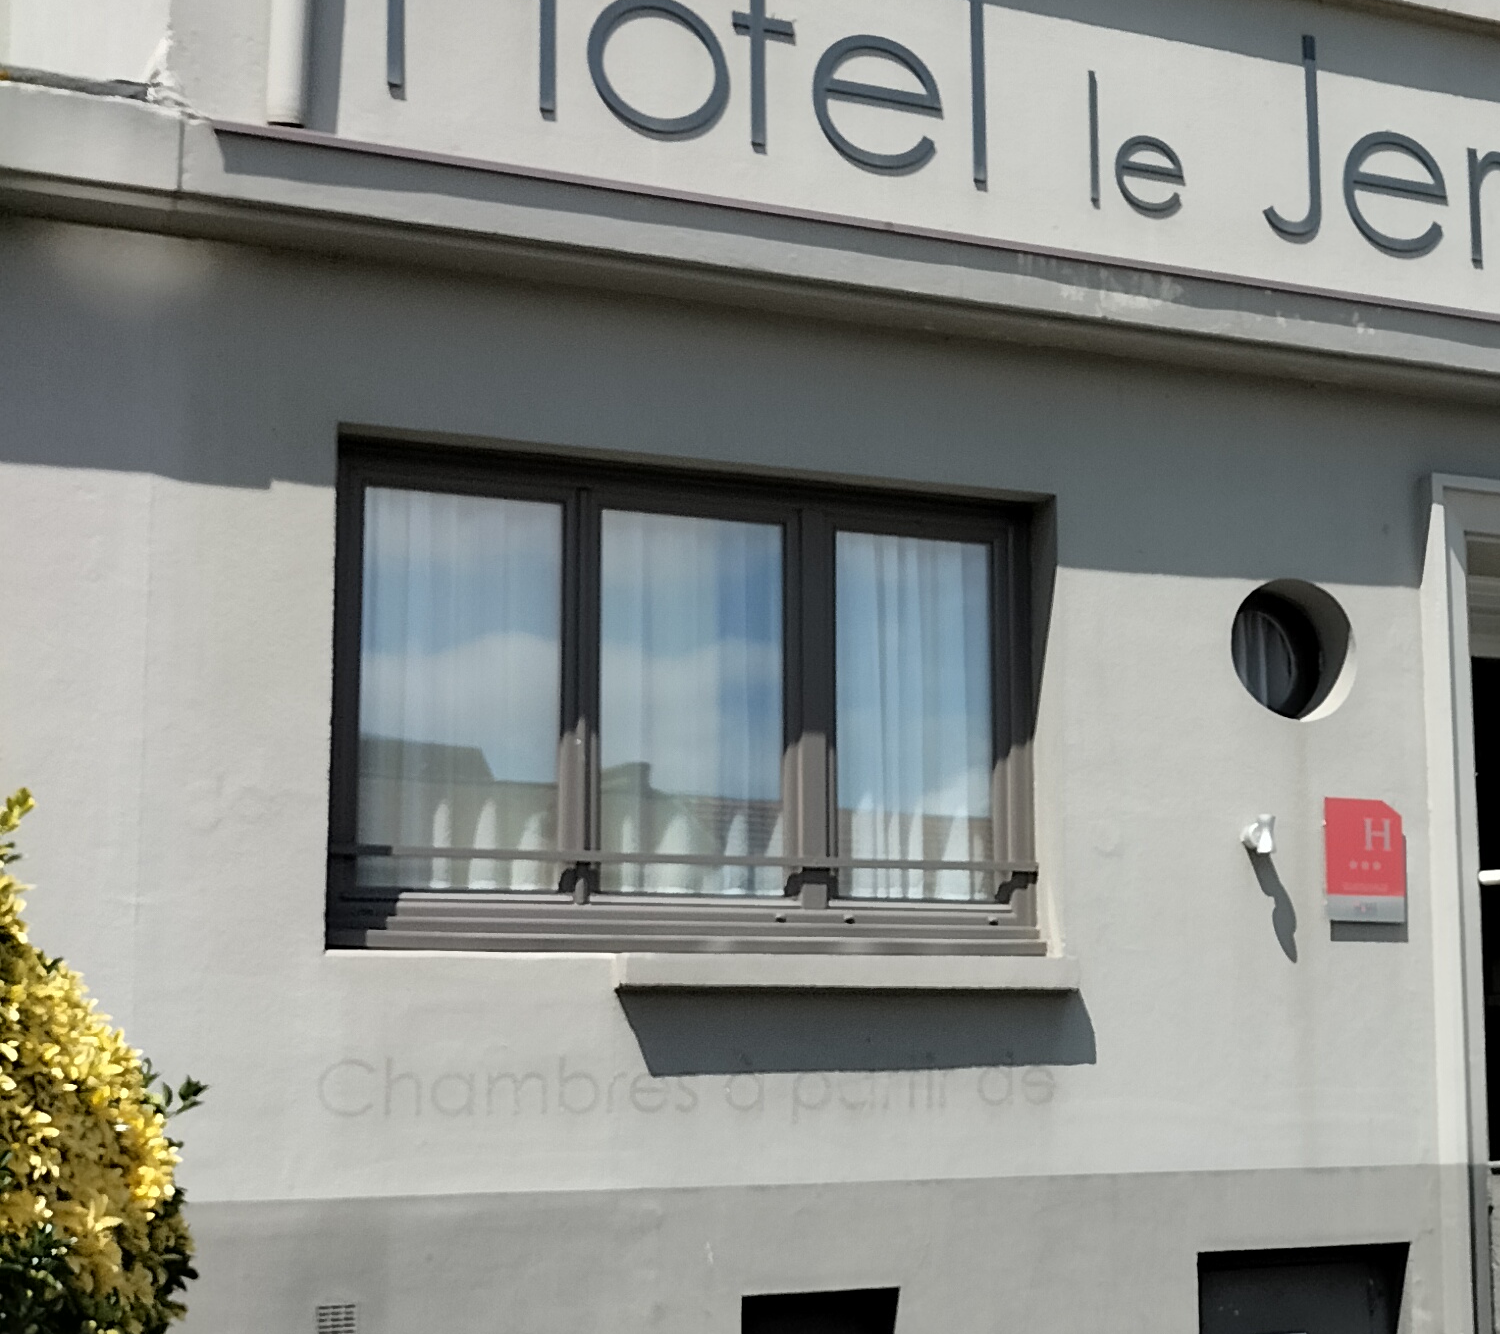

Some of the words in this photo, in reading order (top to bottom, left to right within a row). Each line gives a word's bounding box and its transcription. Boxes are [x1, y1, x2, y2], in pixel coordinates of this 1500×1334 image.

[1086, 69, 1185, 219] le
[1364, 818, 1392, 851] H
[317, 1057, 699, 1118] Chambres
